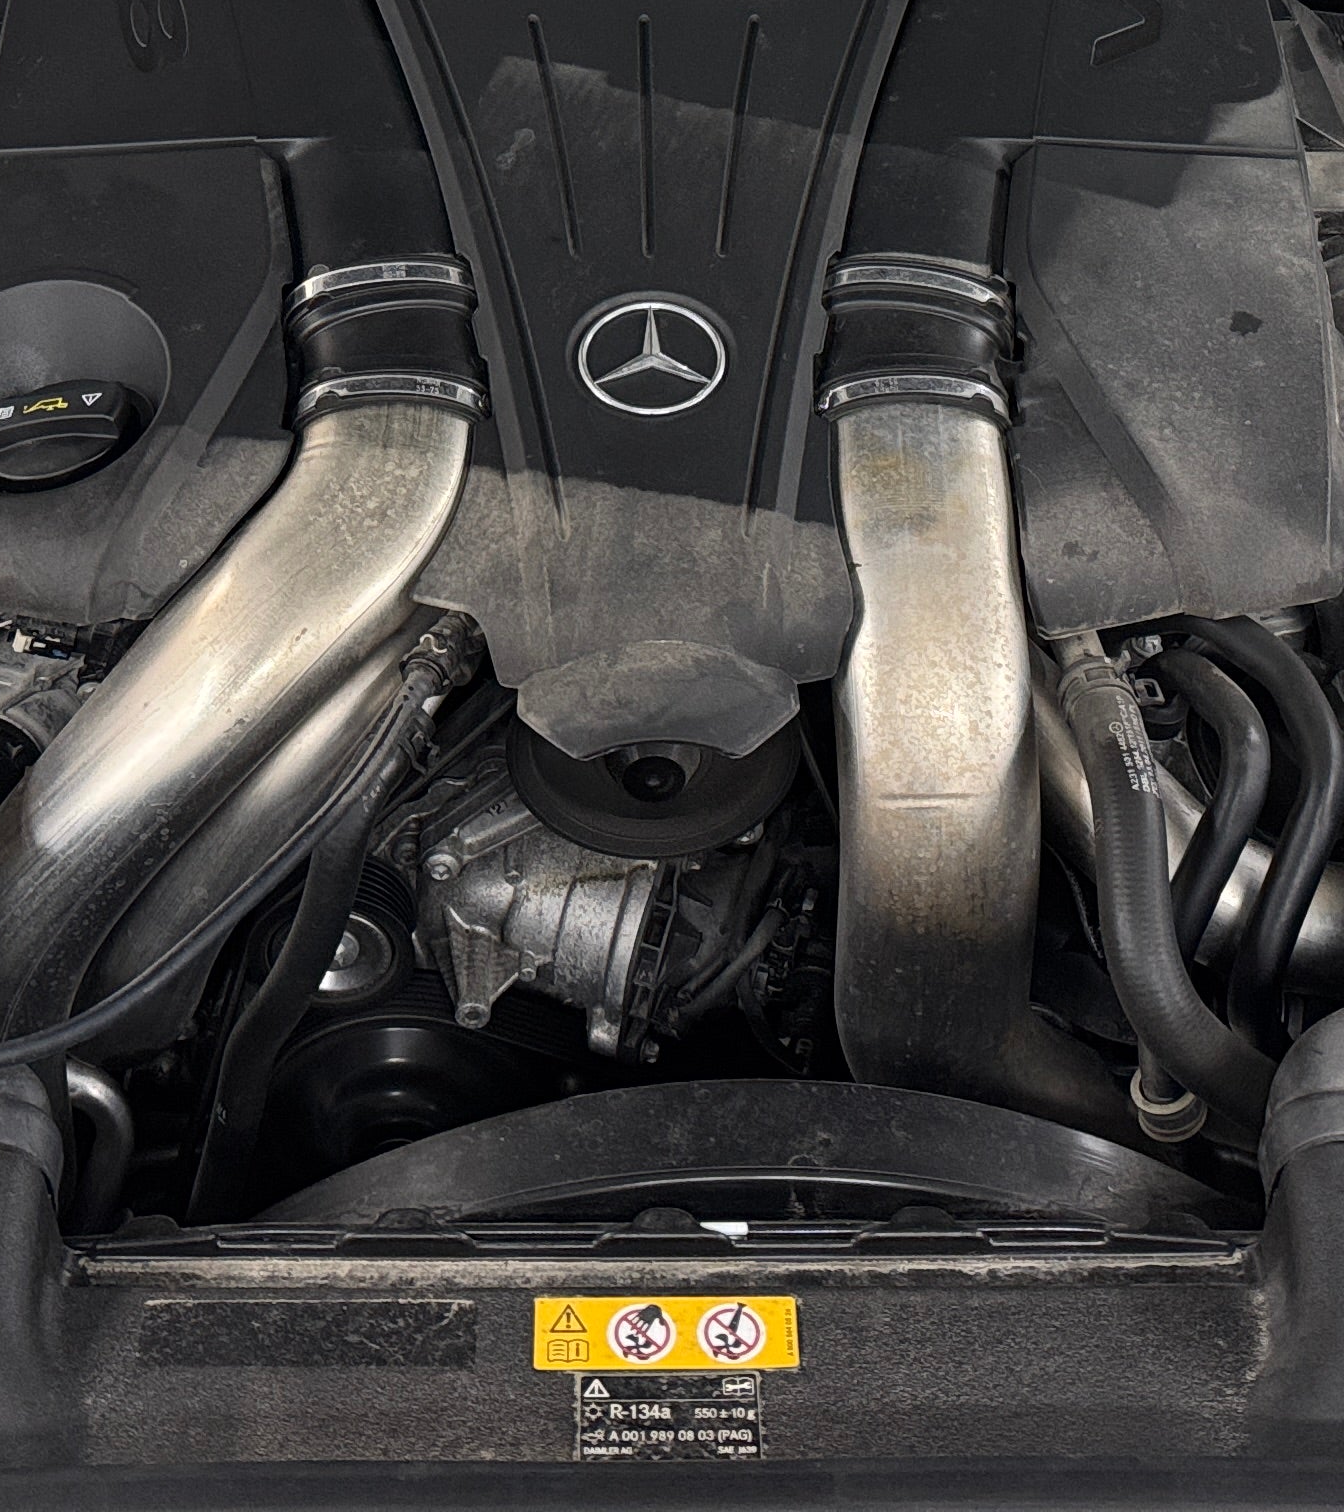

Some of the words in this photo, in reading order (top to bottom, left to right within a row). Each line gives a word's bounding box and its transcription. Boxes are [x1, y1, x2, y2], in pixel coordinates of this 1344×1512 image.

[609, 1403, 672, 1420] R-134a
[694, 1407, 718, 1419] 550
[608, 1430, 620, 1442] A
[621, 1430, 645, 1442] 001
[649, 1430, 675, 1442] 989
[677, 1430, 695, 1442] 08
[697, 1429, 715, 1441] 03
[717, 1429, 753, 1444] (PAG)
